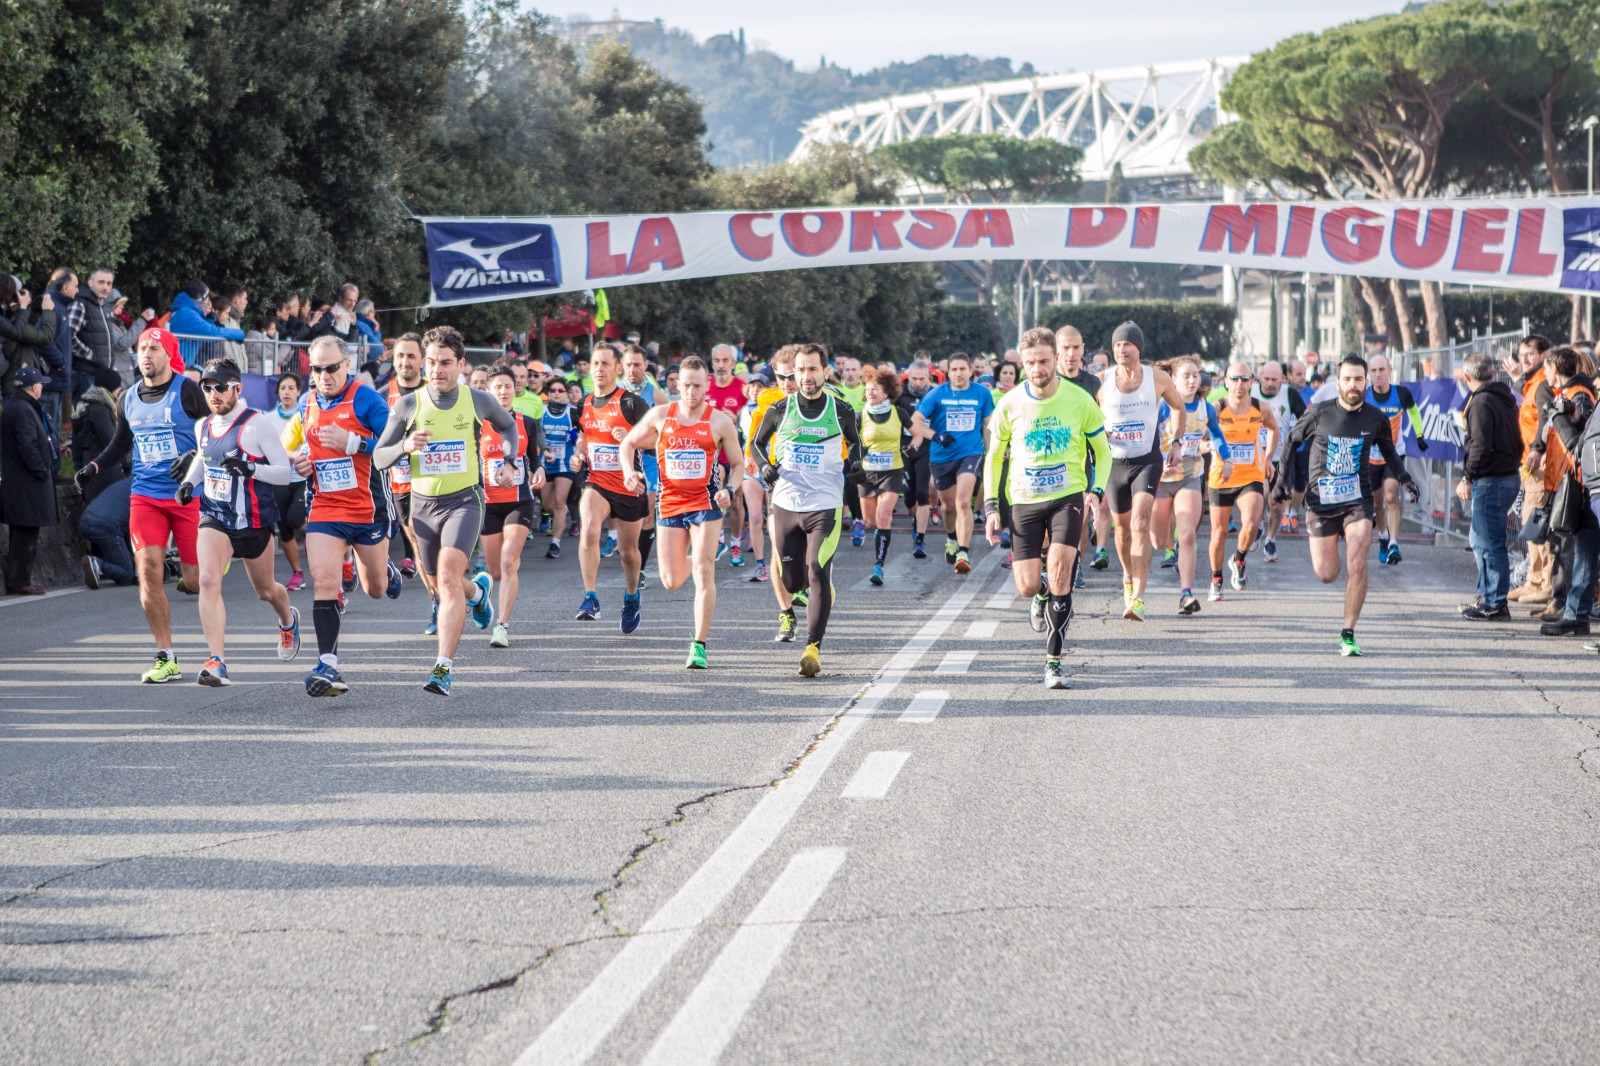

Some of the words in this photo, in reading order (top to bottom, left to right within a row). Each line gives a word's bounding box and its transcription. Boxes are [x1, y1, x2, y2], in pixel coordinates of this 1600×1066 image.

[585, 216, 686, 280] LA
[728, 208, 1015, 262] CORSA
[1064, 206, 1161, 249] DI
[1197, 203, 1559, 278] MIGUEL
[585, 420, 607, 430] GATE
[950, 418, 972, 426] 2153
[667, 437, 697, 447] GATE
[1115, 431, 1143, 442] 4488
[142, 440, 172, 454] 2715
[1337, 443, 1352, 454] WE
[424, 452, 461, 465] 3345
[789, 454, 820, 465] 2582
[1334, 453, 1354, 464] RUN
[671, 461, 702, 471] 3626
[1330, 463, 1357, 474] ROME
[319, 470, 351, 483] 1538
[1030, 475, 1064, 487] 2289
[1324, 483, 1355, 496] 2205
